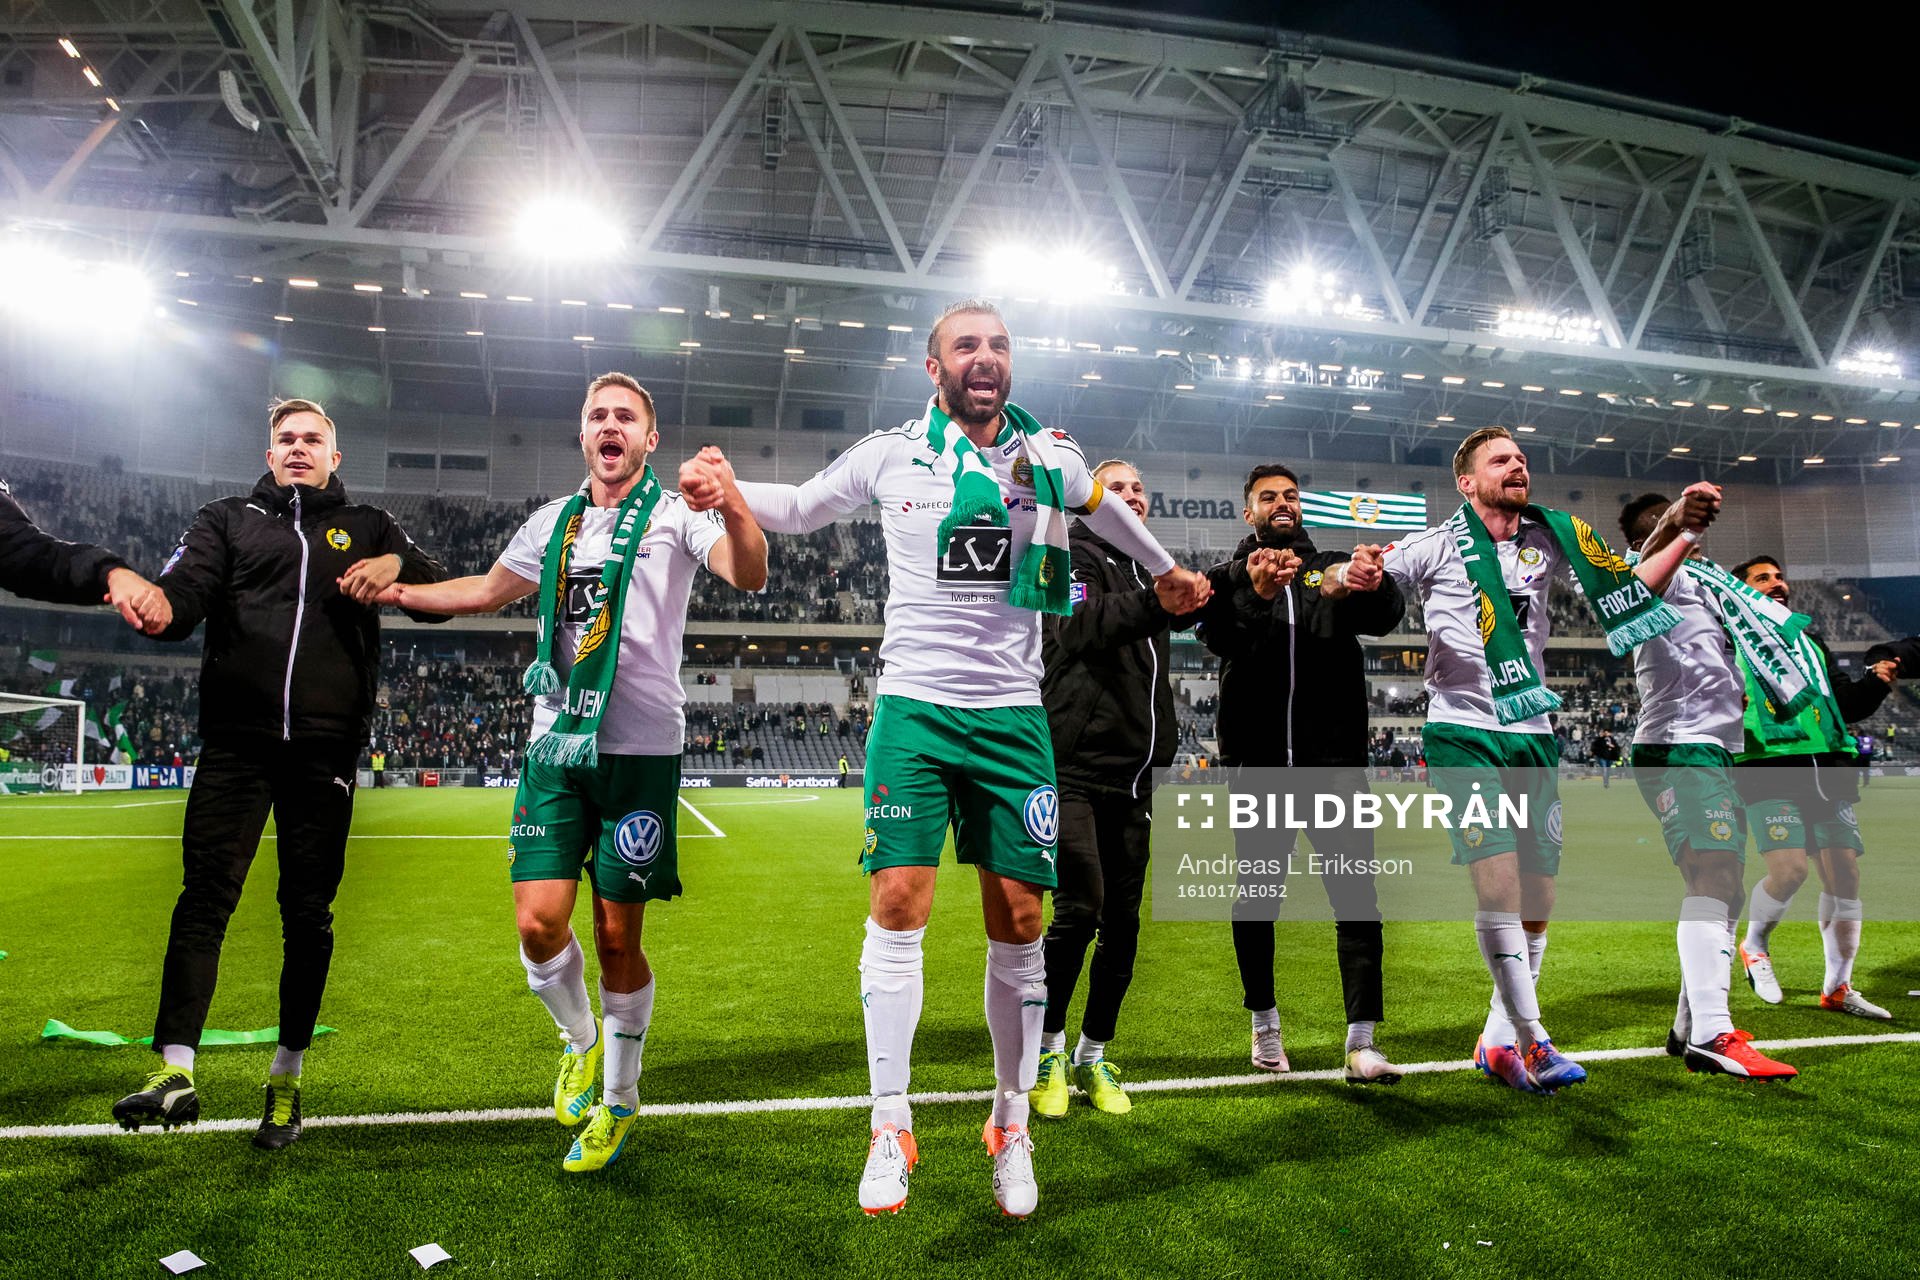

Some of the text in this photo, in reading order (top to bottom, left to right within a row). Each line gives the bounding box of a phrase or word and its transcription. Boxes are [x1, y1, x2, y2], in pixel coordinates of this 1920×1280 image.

[1148, 492, 1235, 520] Arena
[951, 592, 996, 603] lwab.se
[1597, 579, 1653, 619] FORZA
[746, 776, 838, 789] Sefina pantbank
